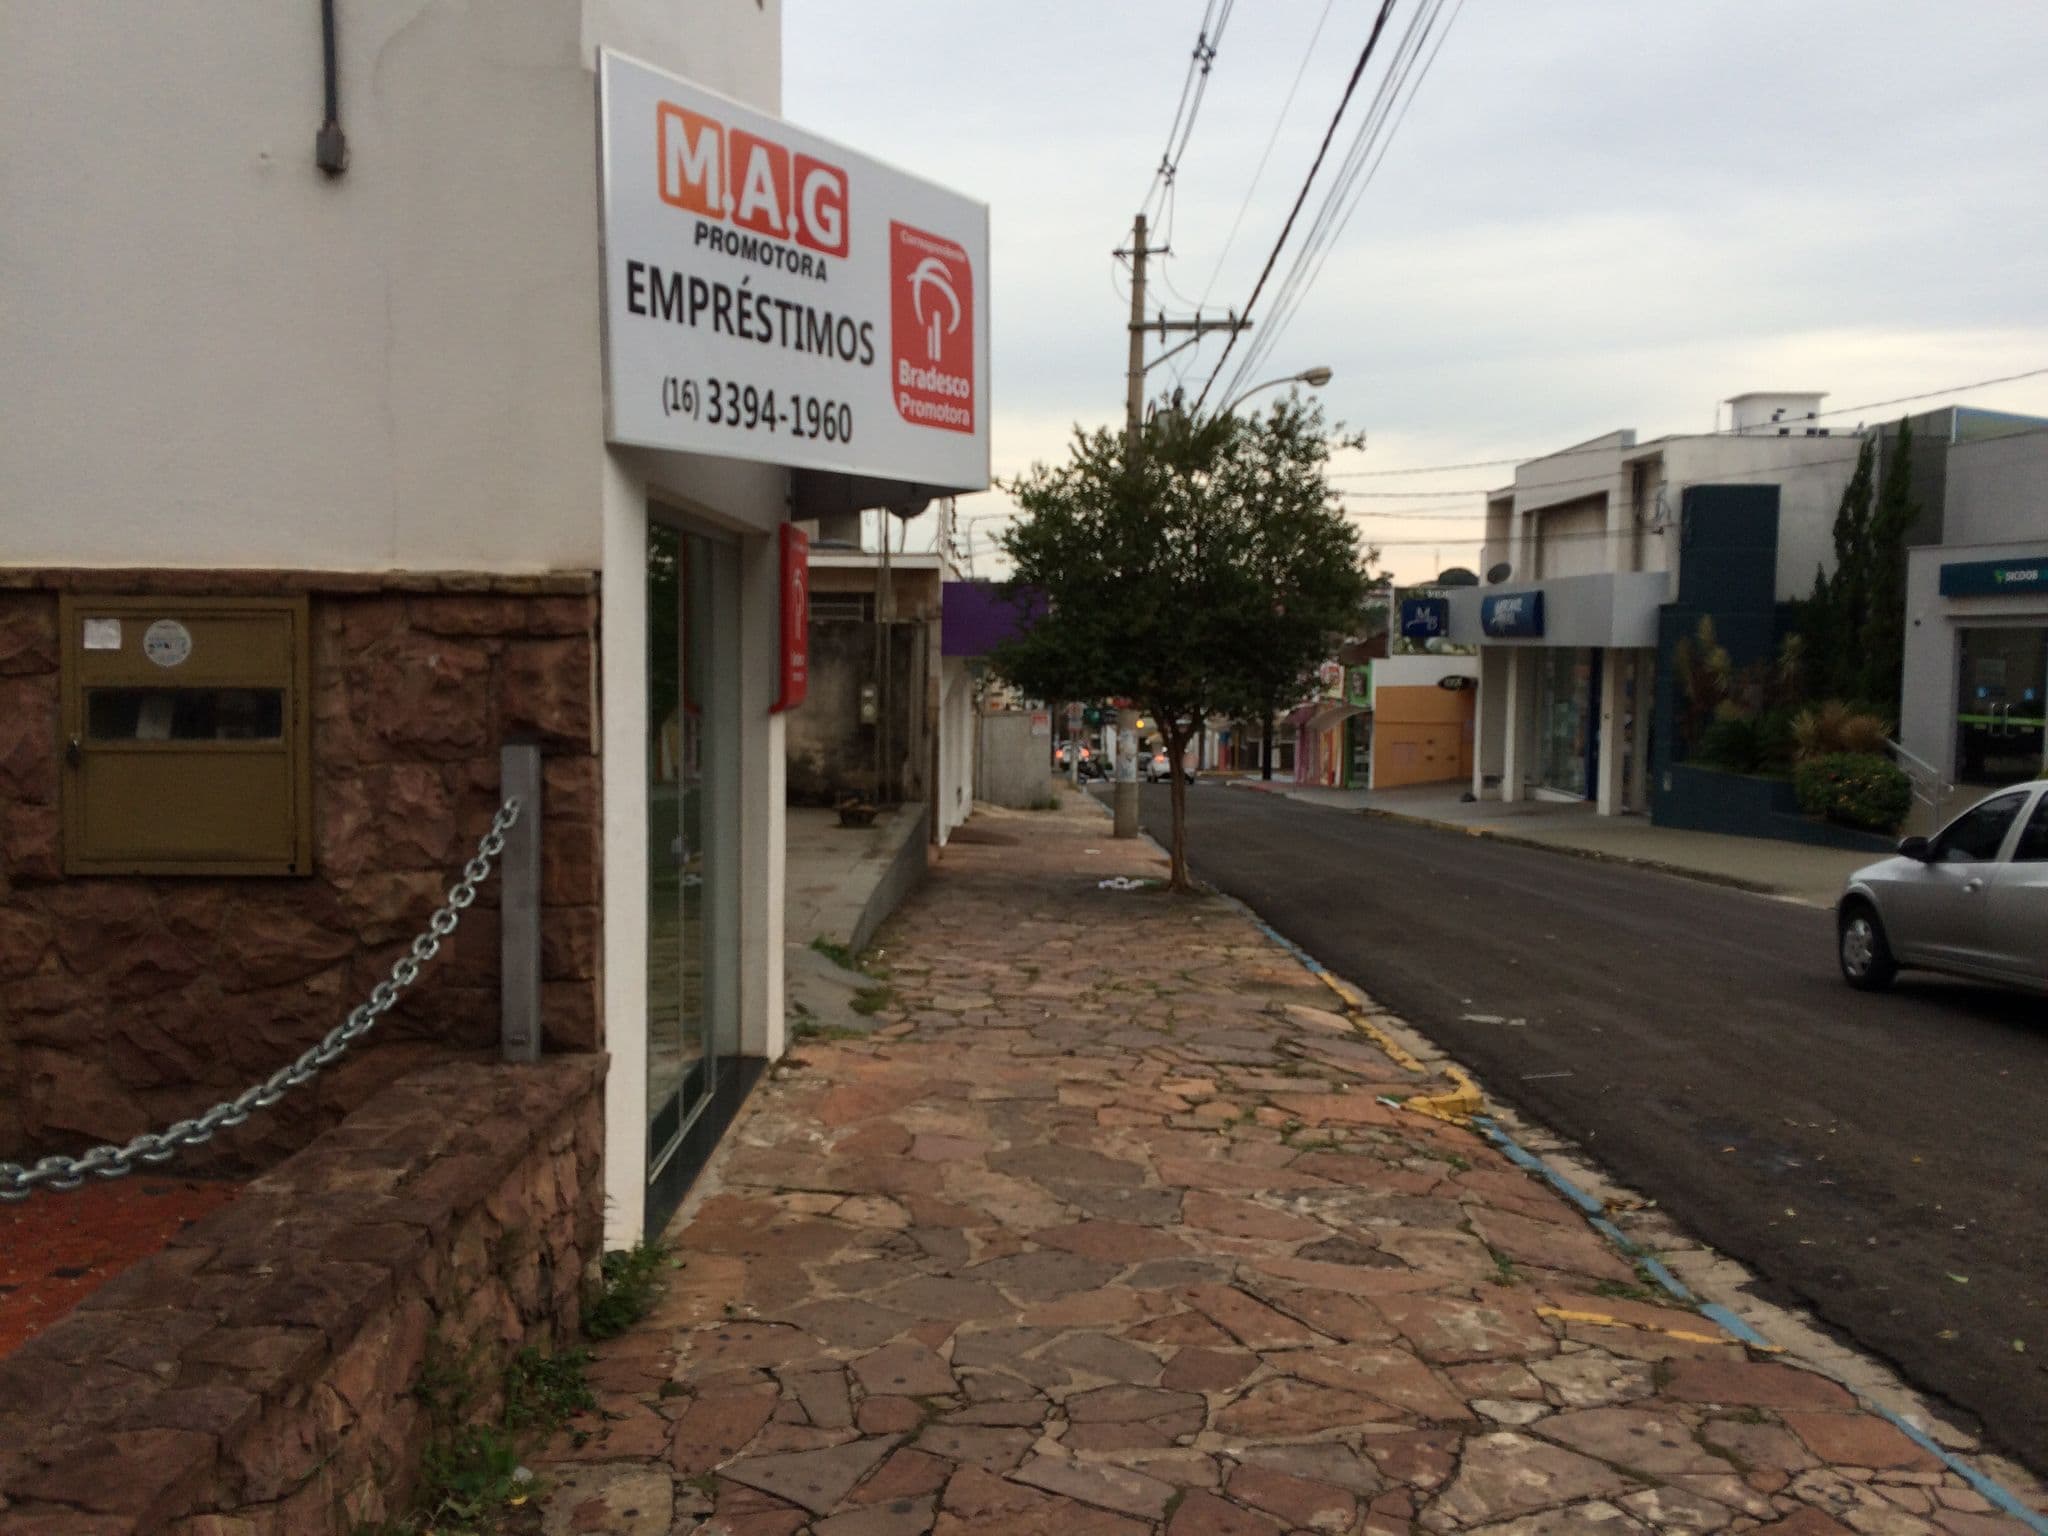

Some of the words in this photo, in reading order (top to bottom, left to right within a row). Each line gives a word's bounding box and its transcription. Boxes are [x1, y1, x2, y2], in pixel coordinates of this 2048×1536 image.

[694, 222, 827, 282] PROMOTORA
[626, 259, 875, 366] EMPRÉSTIMOS
[898, 358, 970, 399] Bradesco
[662, 376, 700, 420] (16)
[707, 378, 853, 444] 3394-1960
[899, 392, 970, 427] Promotora
[2005, 569, 2039, 582] SICOOB
